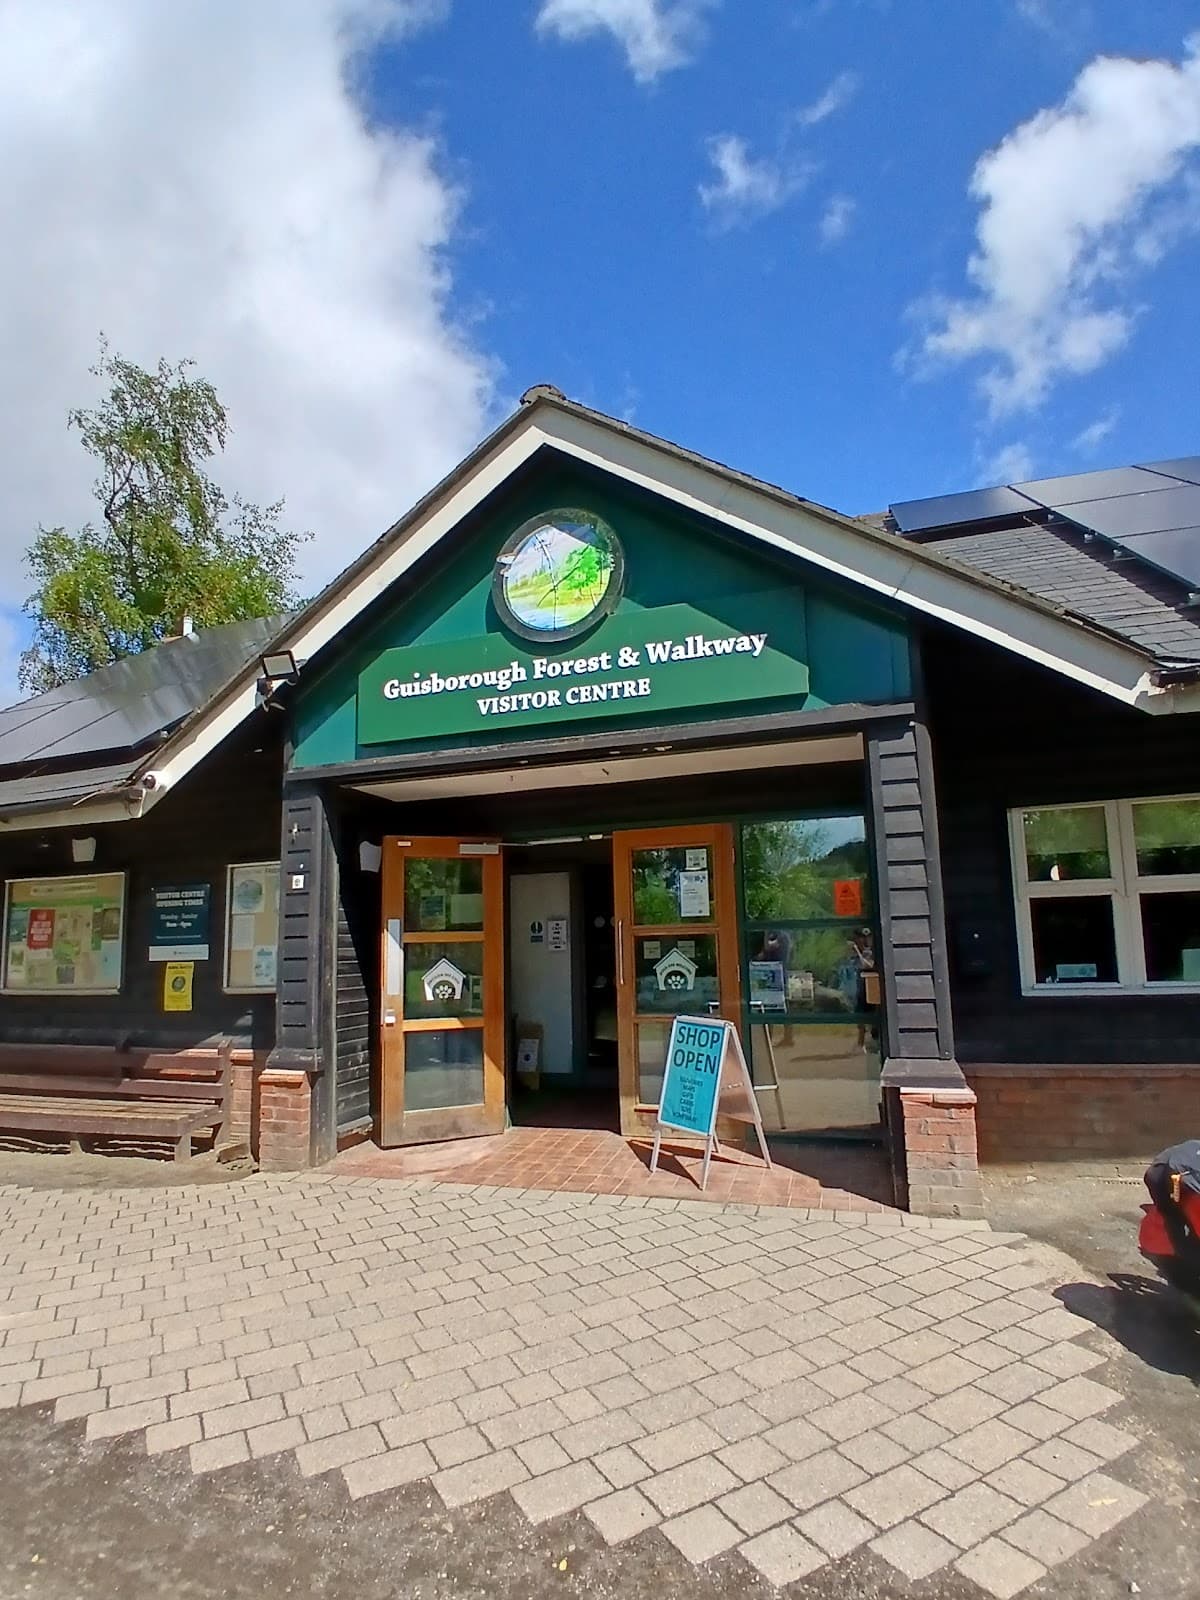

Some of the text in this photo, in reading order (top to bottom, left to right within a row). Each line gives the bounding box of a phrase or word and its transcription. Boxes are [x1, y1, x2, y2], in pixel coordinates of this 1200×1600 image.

[383, 633, 769, 700] Guisborough Forest & Walkway
[476, 677, 651, 716] VISITOR CENTRE
[181, 889, 205, 898] CENTRE
[676, 1025, 721, 1050] SHOP
[673, 1048, 717, 1075] OPEN
